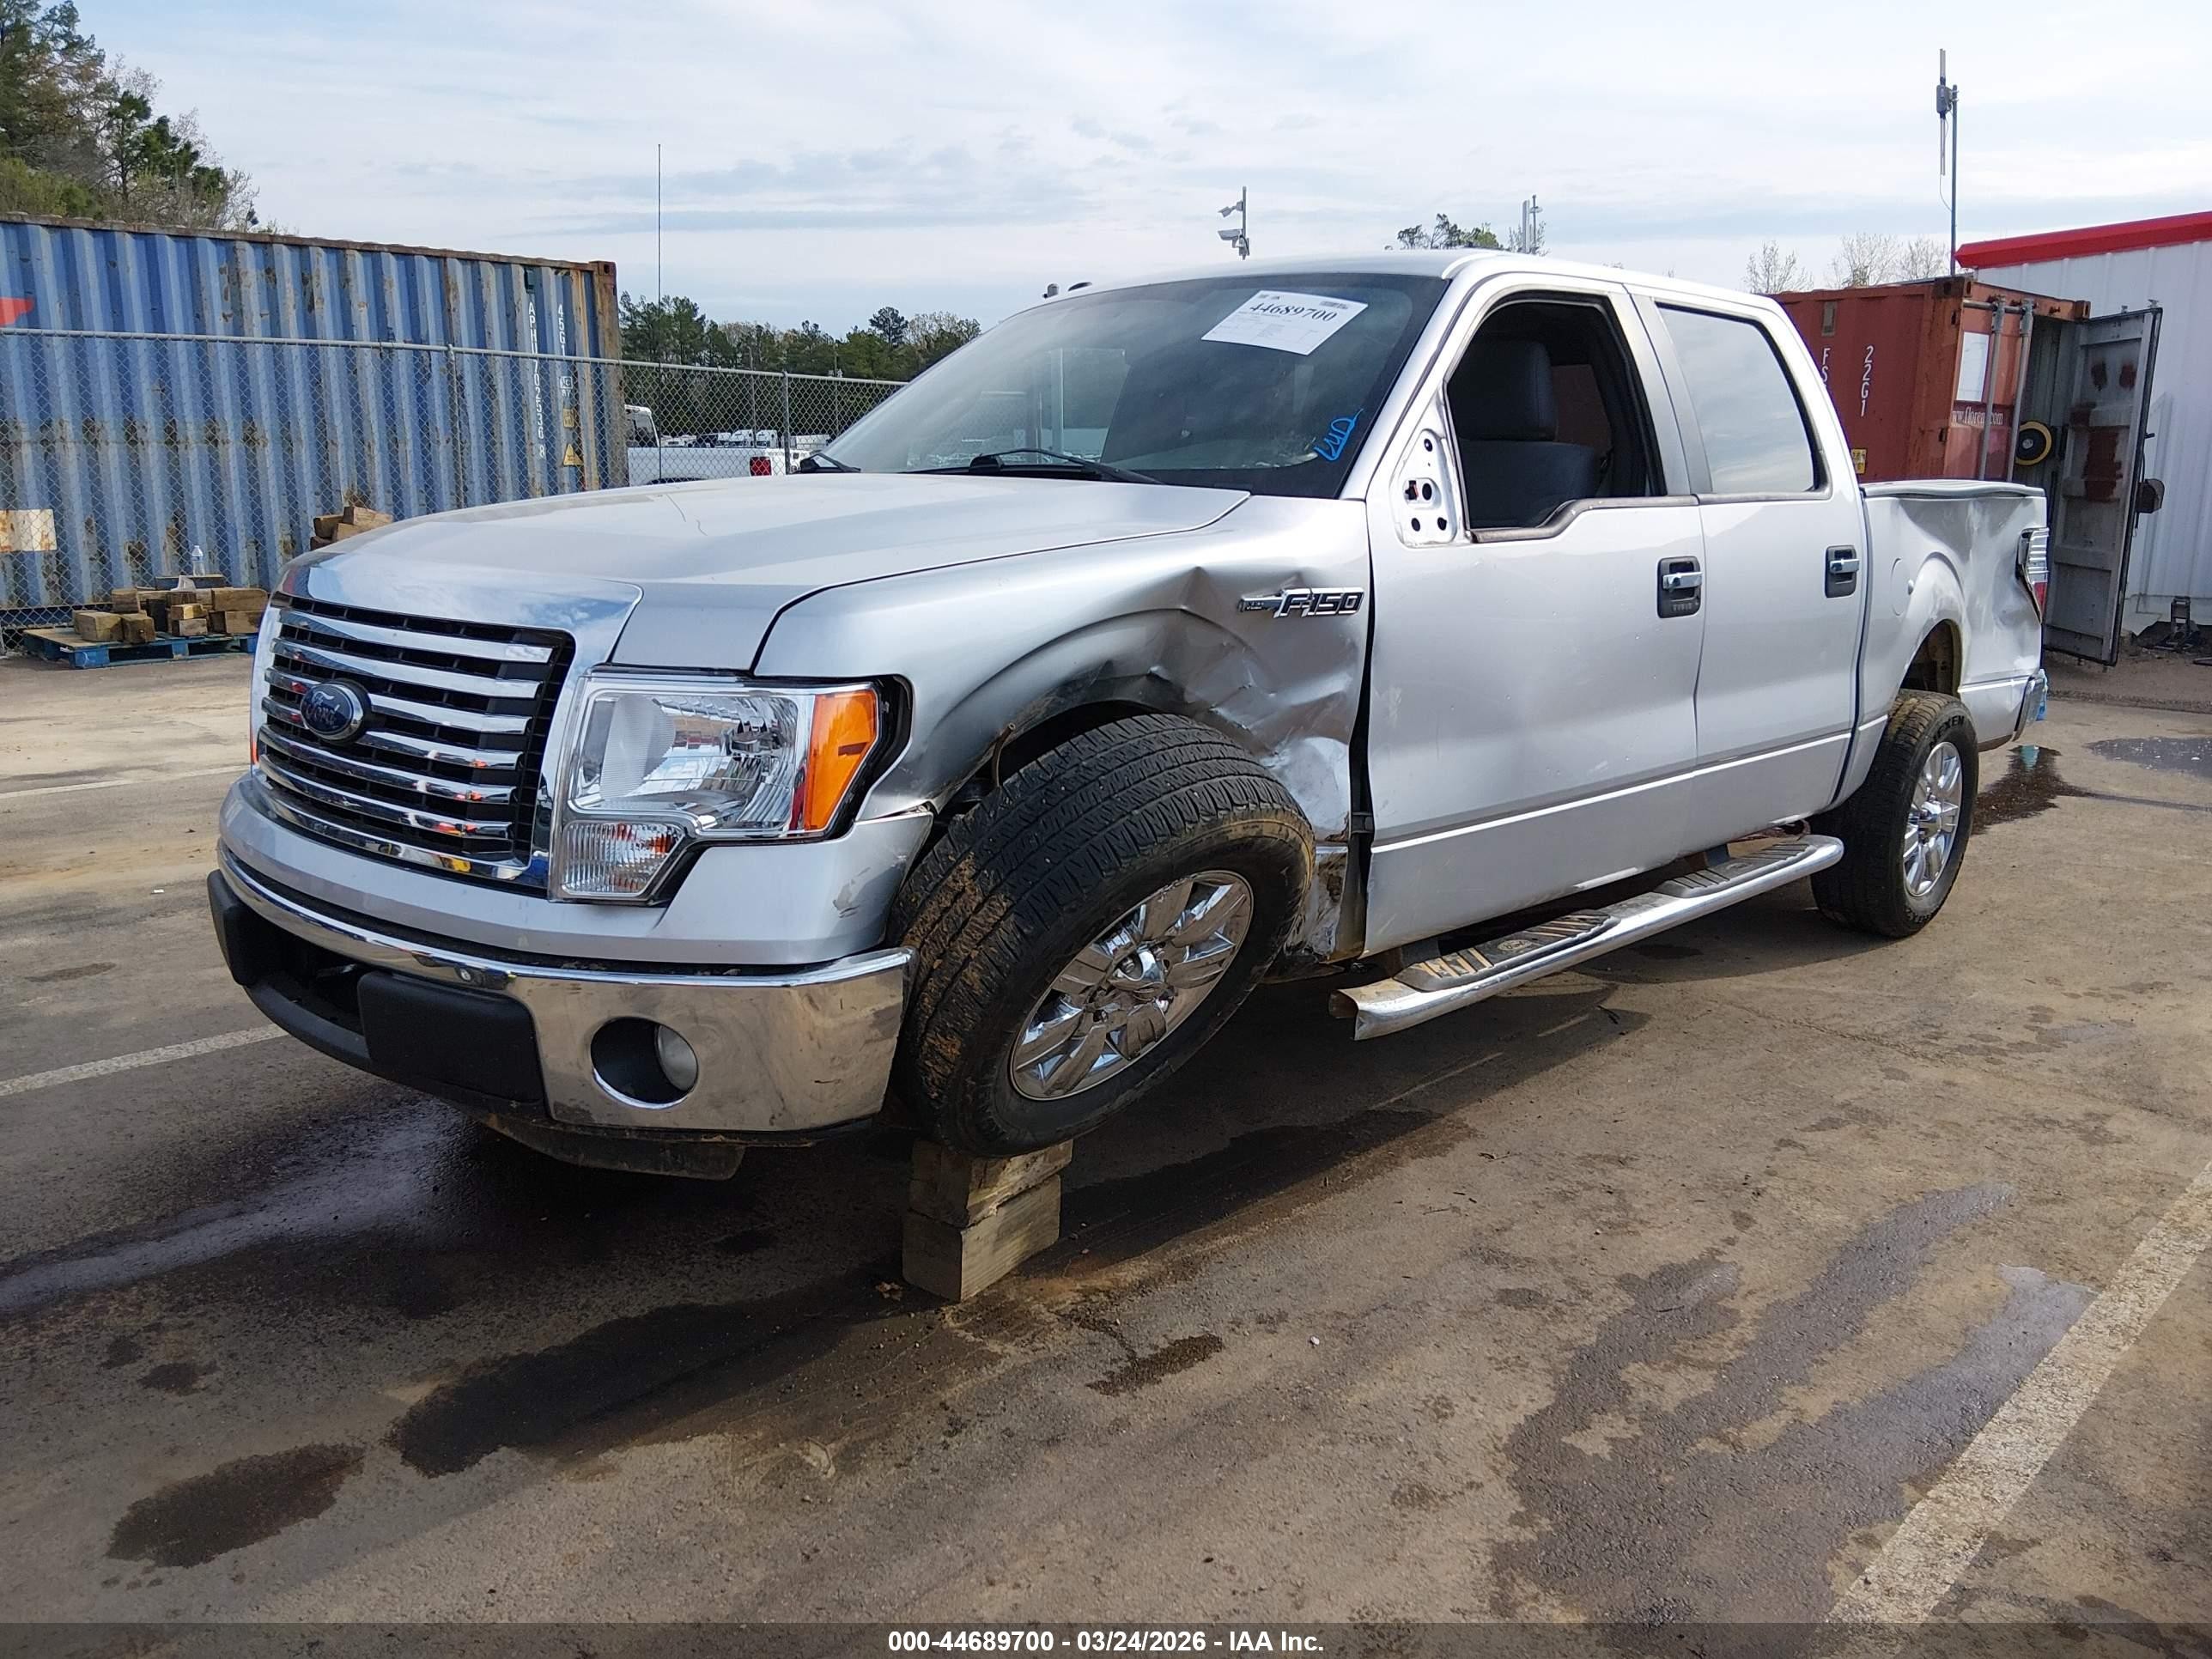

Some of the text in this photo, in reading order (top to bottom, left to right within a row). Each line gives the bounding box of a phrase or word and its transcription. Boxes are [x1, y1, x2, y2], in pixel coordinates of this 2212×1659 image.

[558, 304, 568, 357] 45G1
[1250, 302, 1338, 322] 44689700
[1821, 347, 1832, 386] FS
[1860, 345, 1875, 417] 22G1
